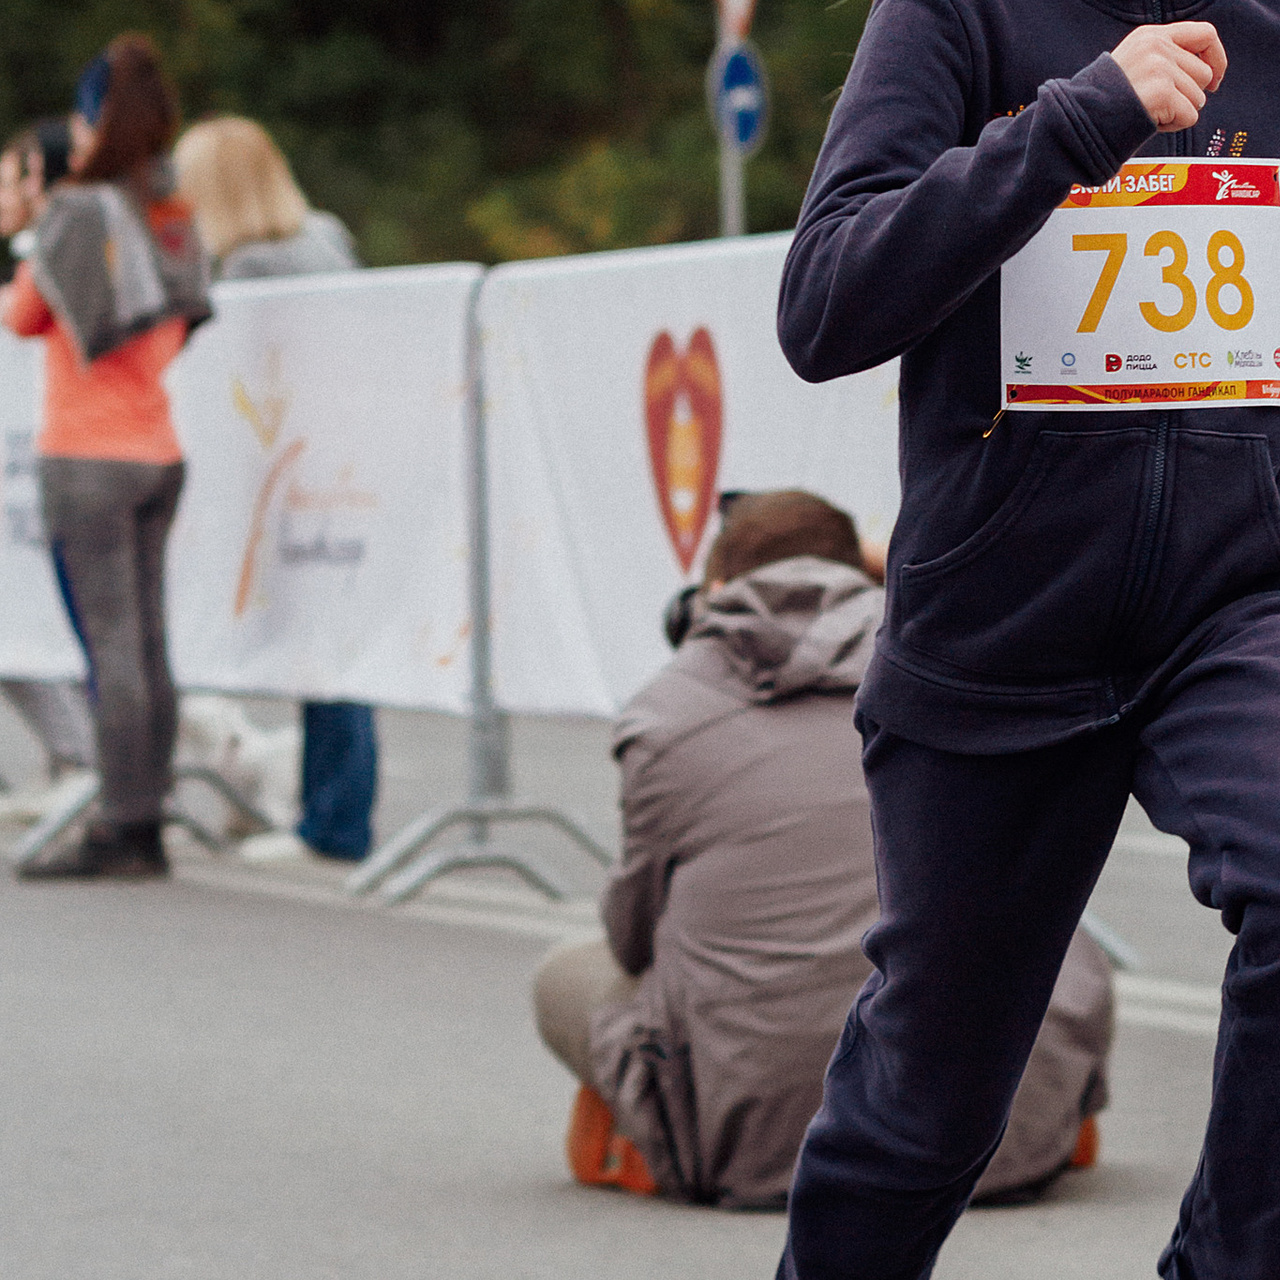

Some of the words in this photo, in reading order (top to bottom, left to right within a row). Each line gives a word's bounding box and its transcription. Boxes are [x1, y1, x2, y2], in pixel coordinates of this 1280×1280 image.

[1125, 174, 1175, 193] ЗАБЕГ
[1072, 230, 1254, 333] 738
[1126, 354, 1152, 363] ДОДО
[1173, 352, 1212, 369] СТС
[1126, 363, 1158, 371] ПИЦЦА
[1104, 387, 1185, 400] ПОЛУМАРАФОН
[1188, 385, 1237, 398] ГАНДИКАП
